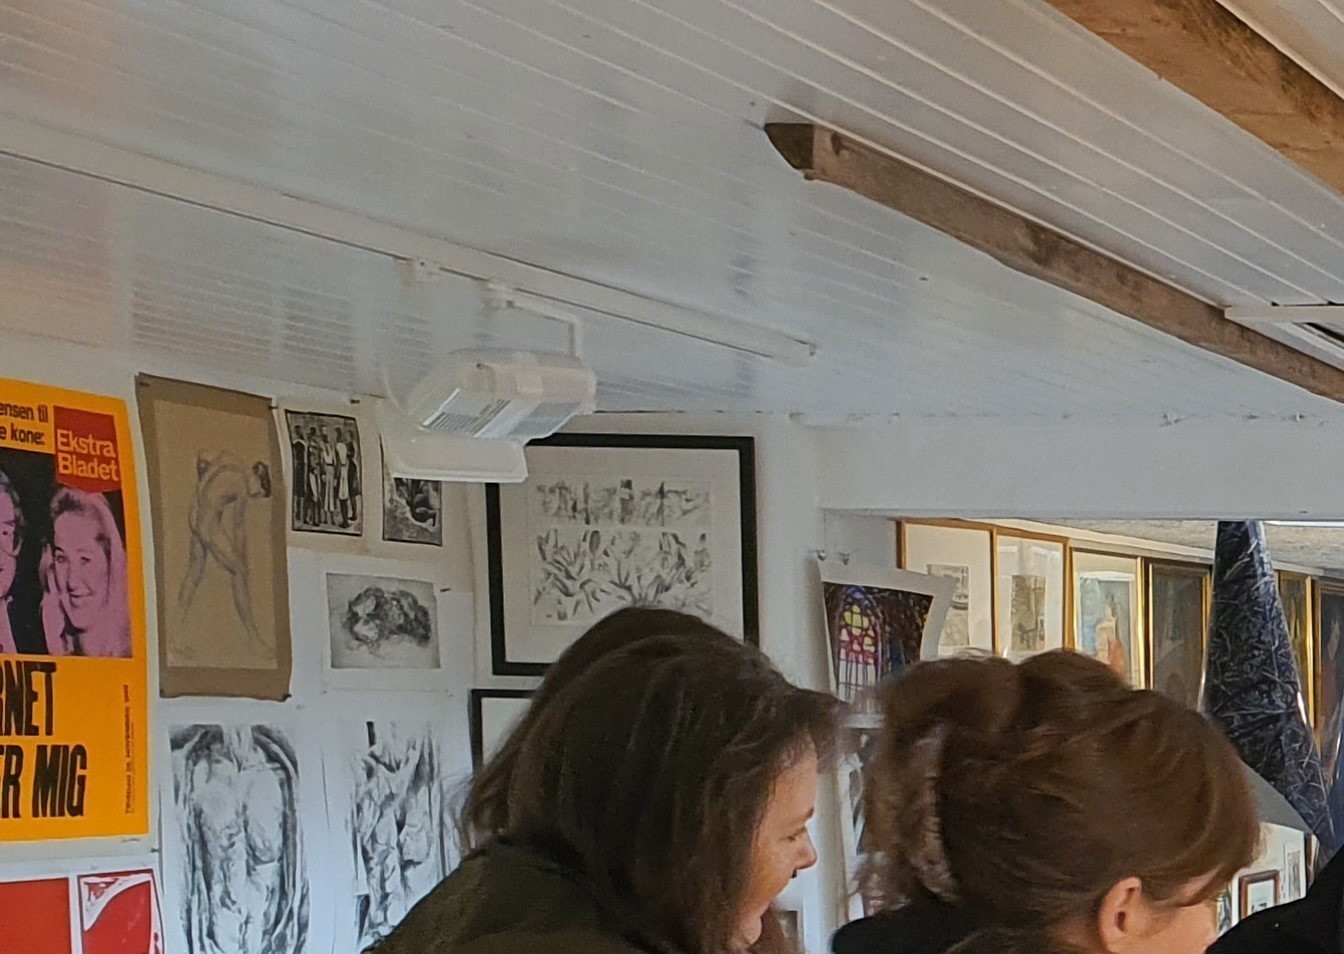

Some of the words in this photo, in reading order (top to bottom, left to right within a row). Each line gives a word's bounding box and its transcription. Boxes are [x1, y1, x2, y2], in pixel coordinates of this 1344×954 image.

[37, 404, 49, 423] til
[57, 428, 117, 458] Ekstra
[58, 452, 119, 481] Bladet
[0, 660, 57, 737] NET
[32, 743, 88, 818] MIG
